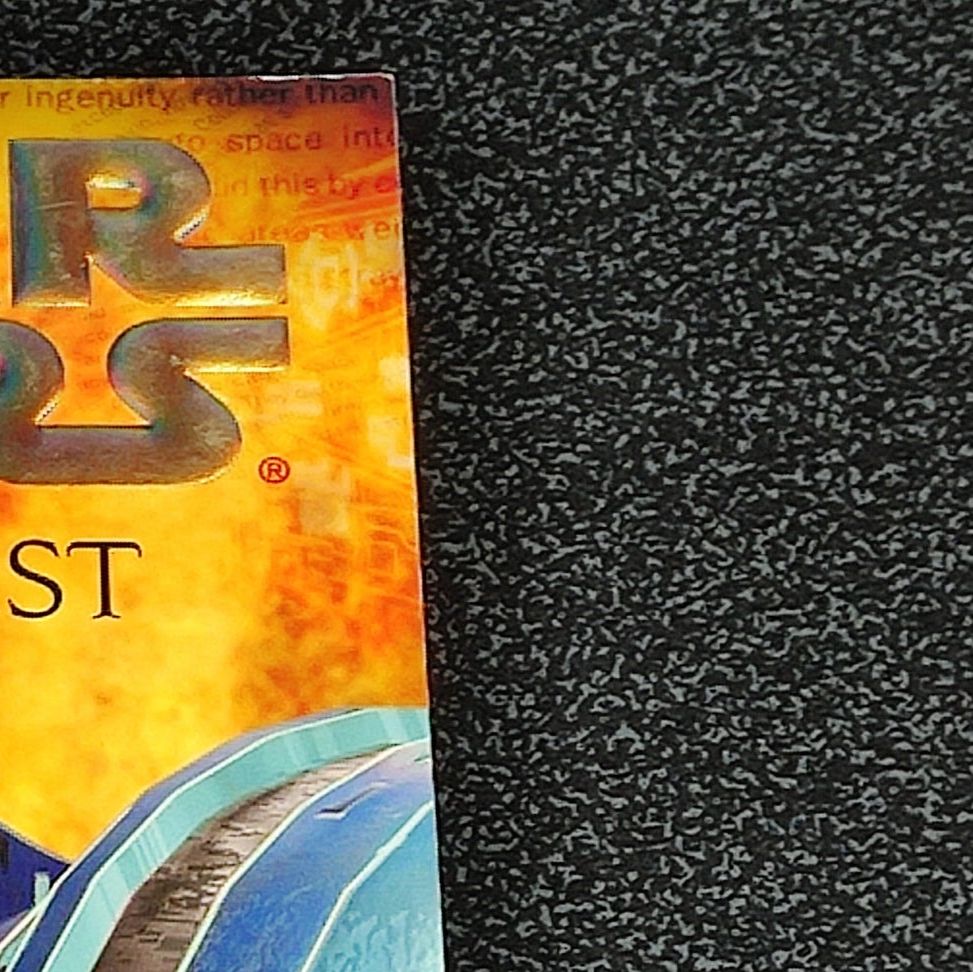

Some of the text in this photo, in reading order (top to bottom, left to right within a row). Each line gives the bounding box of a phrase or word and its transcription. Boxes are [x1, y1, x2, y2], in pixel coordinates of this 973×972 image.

[26, 83, 176, 113] ingenuity
[193, 80, 294, 108] rather
[305, 80, 378, 105] than
